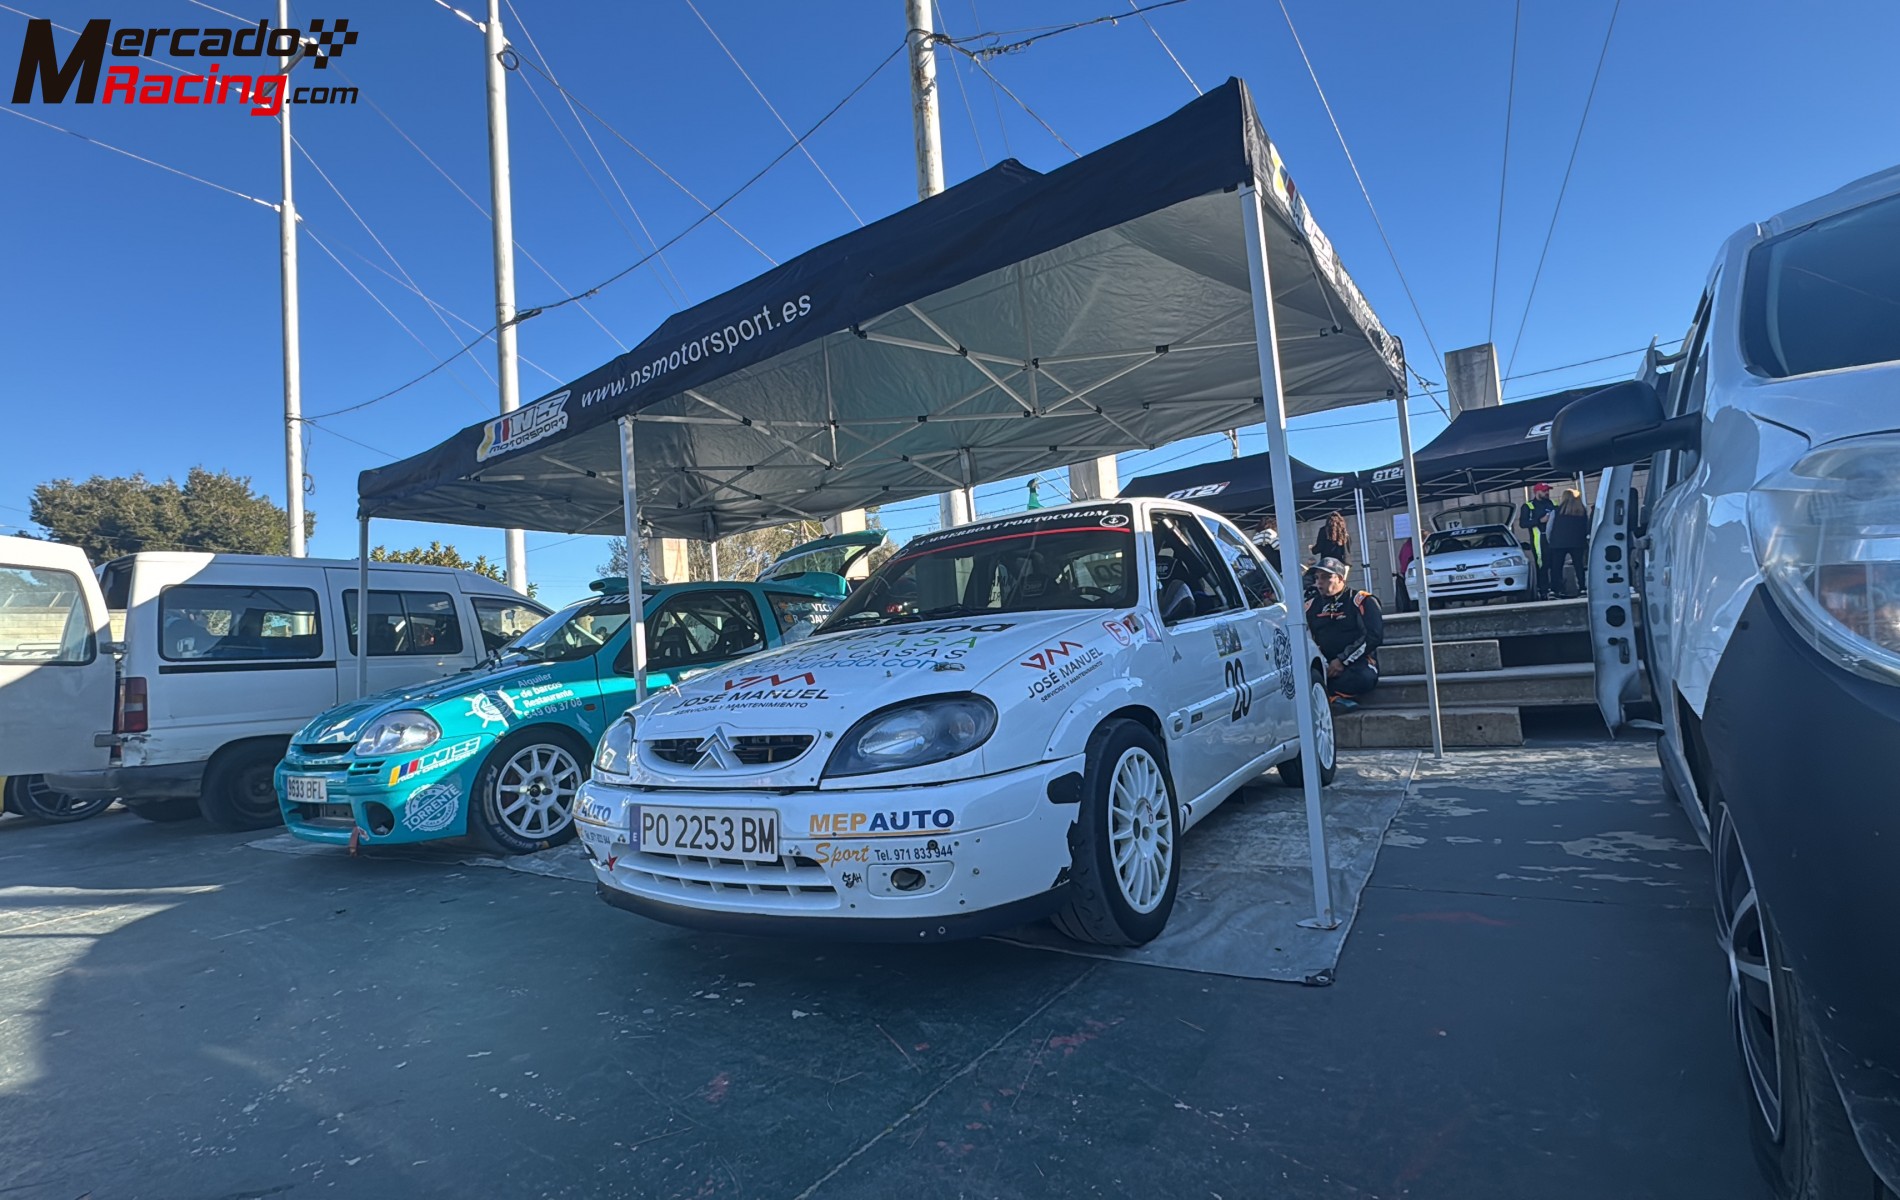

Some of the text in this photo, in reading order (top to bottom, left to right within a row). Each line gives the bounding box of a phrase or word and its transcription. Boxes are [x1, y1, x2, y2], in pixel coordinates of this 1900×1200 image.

[581, 294, 812, 408] www.nsmotorsport.es
[489, 415, 566, 454] MOTORSPORT
[1003, 509, 1110, 528] PORTOCOLOM
[848, 648, 968, 661] CASAS
[517, 672, 552, 688] Alquiler
[1027, 647, 1104, 699] JOSÉ MANUEL
[520, 681, 563, 698] de barcos
[522, 689, 575, 708] Restaurante
[672, 689, 830, 710] JOSÉ MANUEL
[1041, 683, 1067, 703] SERVICIOS
[1225, 658, 1252, 722] 20
[544, 704, 558, 714] 06
[674, 704, 717, 716] SERVICIOS
[725, 702, 809, 711] MANTENIMIENTO
[306, 780, 324, 800] BFL
[403, 785, 460, 830] TORRENTE
[632, 832, 638, 842] E
[642, 812, 669, 847] PO
[675, 814, 735, 851] 2253
[741, 817, 775, 854] BM
[815, 842, 953, 868] Sport Tel. 971 833 944
